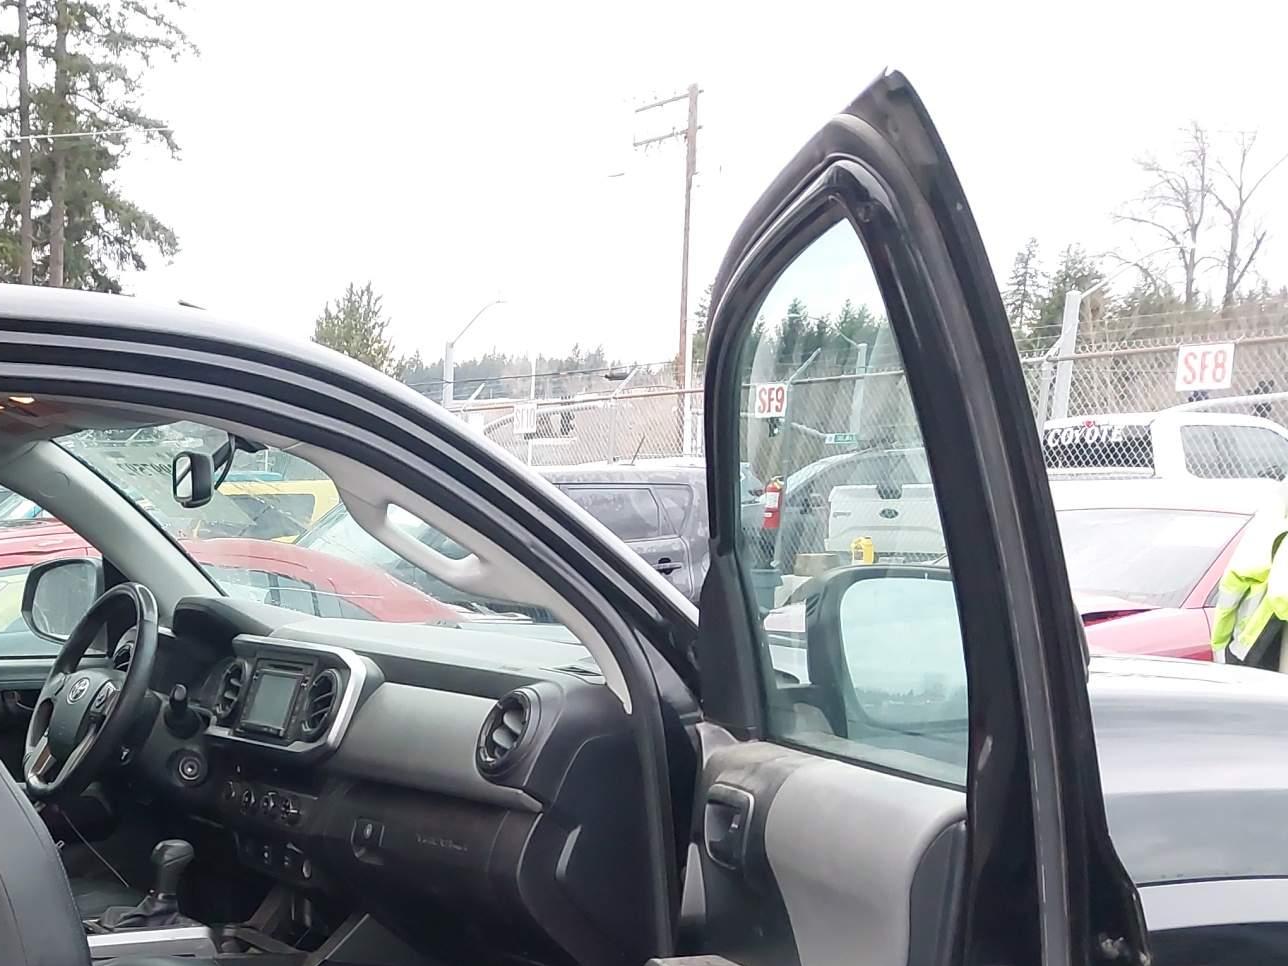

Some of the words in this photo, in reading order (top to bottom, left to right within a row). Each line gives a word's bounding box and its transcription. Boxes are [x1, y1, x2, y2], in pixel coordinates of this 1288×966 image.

[1182, 349, 1227, 385] SF8
[758, 386, 785, 414] SF9
[1047, 425, 1124, 448] COYOTE
